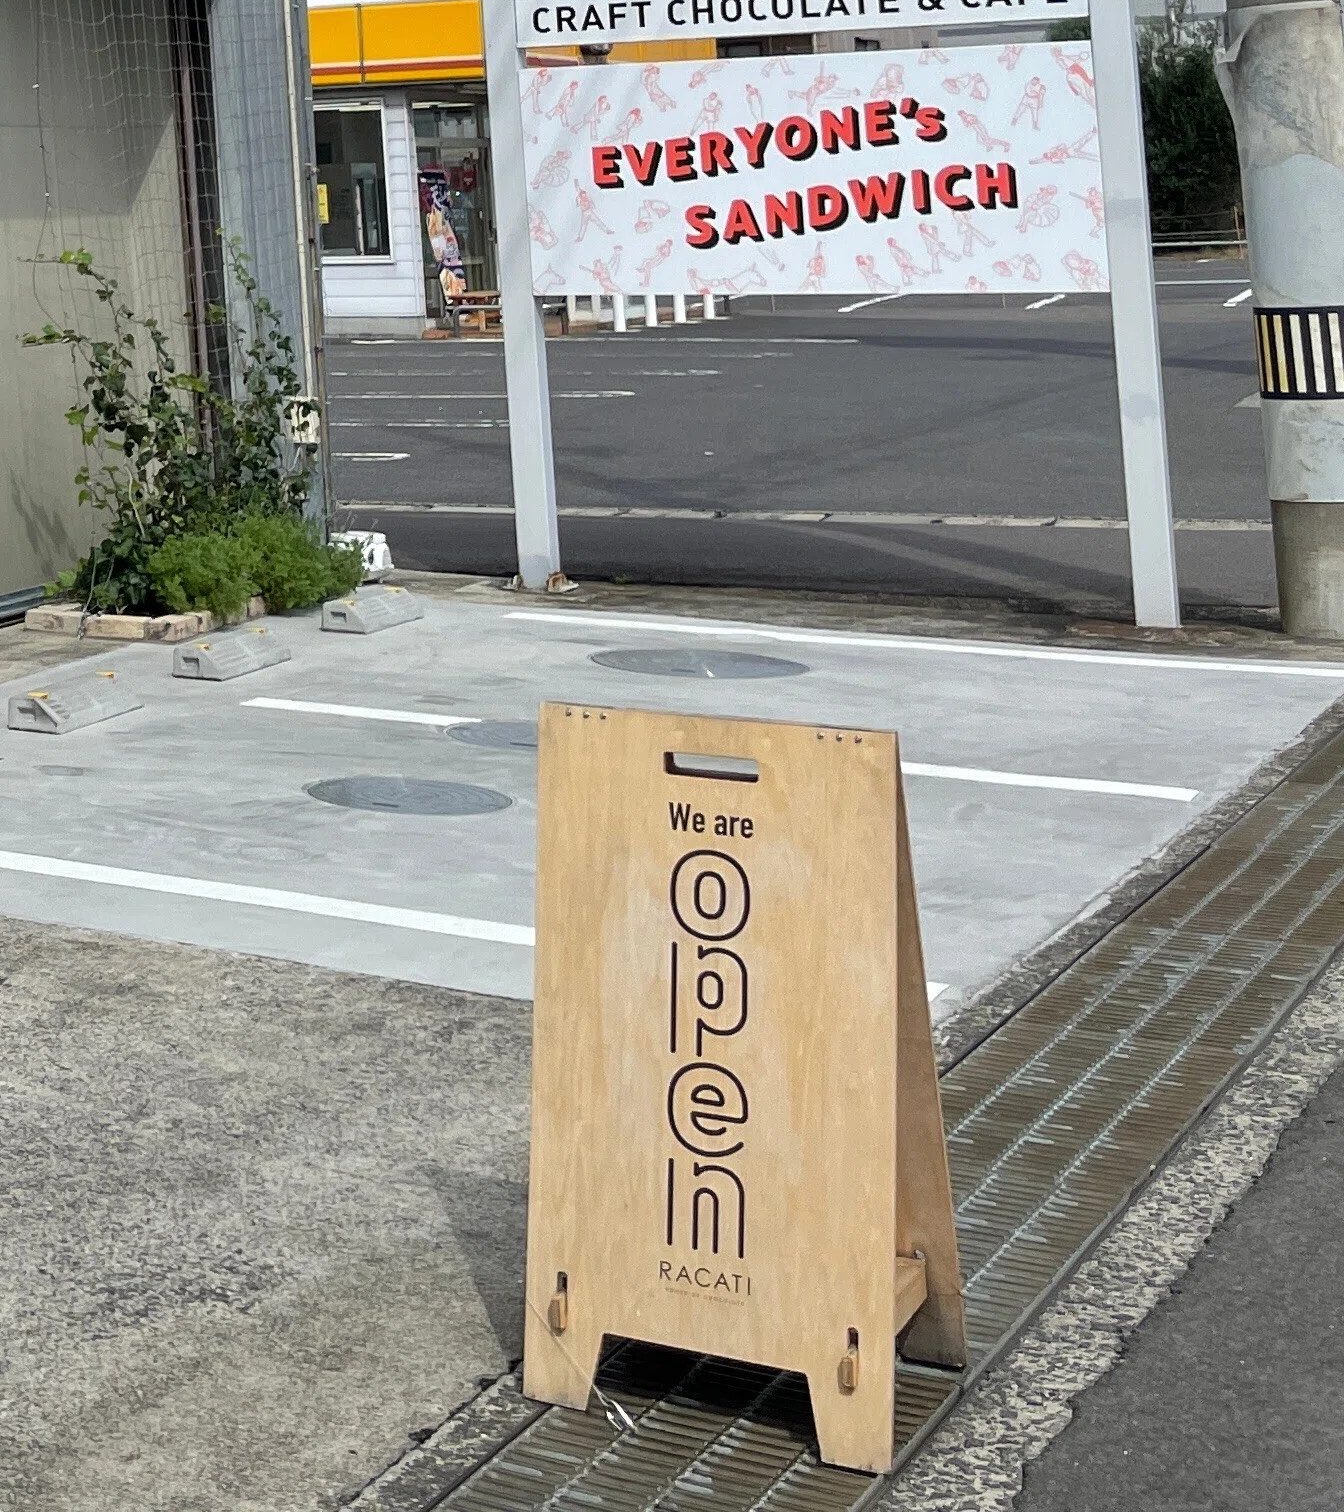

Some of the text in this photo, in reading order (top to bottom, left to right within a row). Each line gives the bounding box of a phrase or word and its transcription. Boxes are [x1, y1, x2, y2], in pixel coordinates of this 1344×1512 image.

[531, 1, 652, 35] CRAFT
[684, 161, 1019, 249] SANDWICH
[668, 801, 755, 839] We are
[667, 849, 752, 1259] open
[658, 1260, 752, 1297] RACATI
